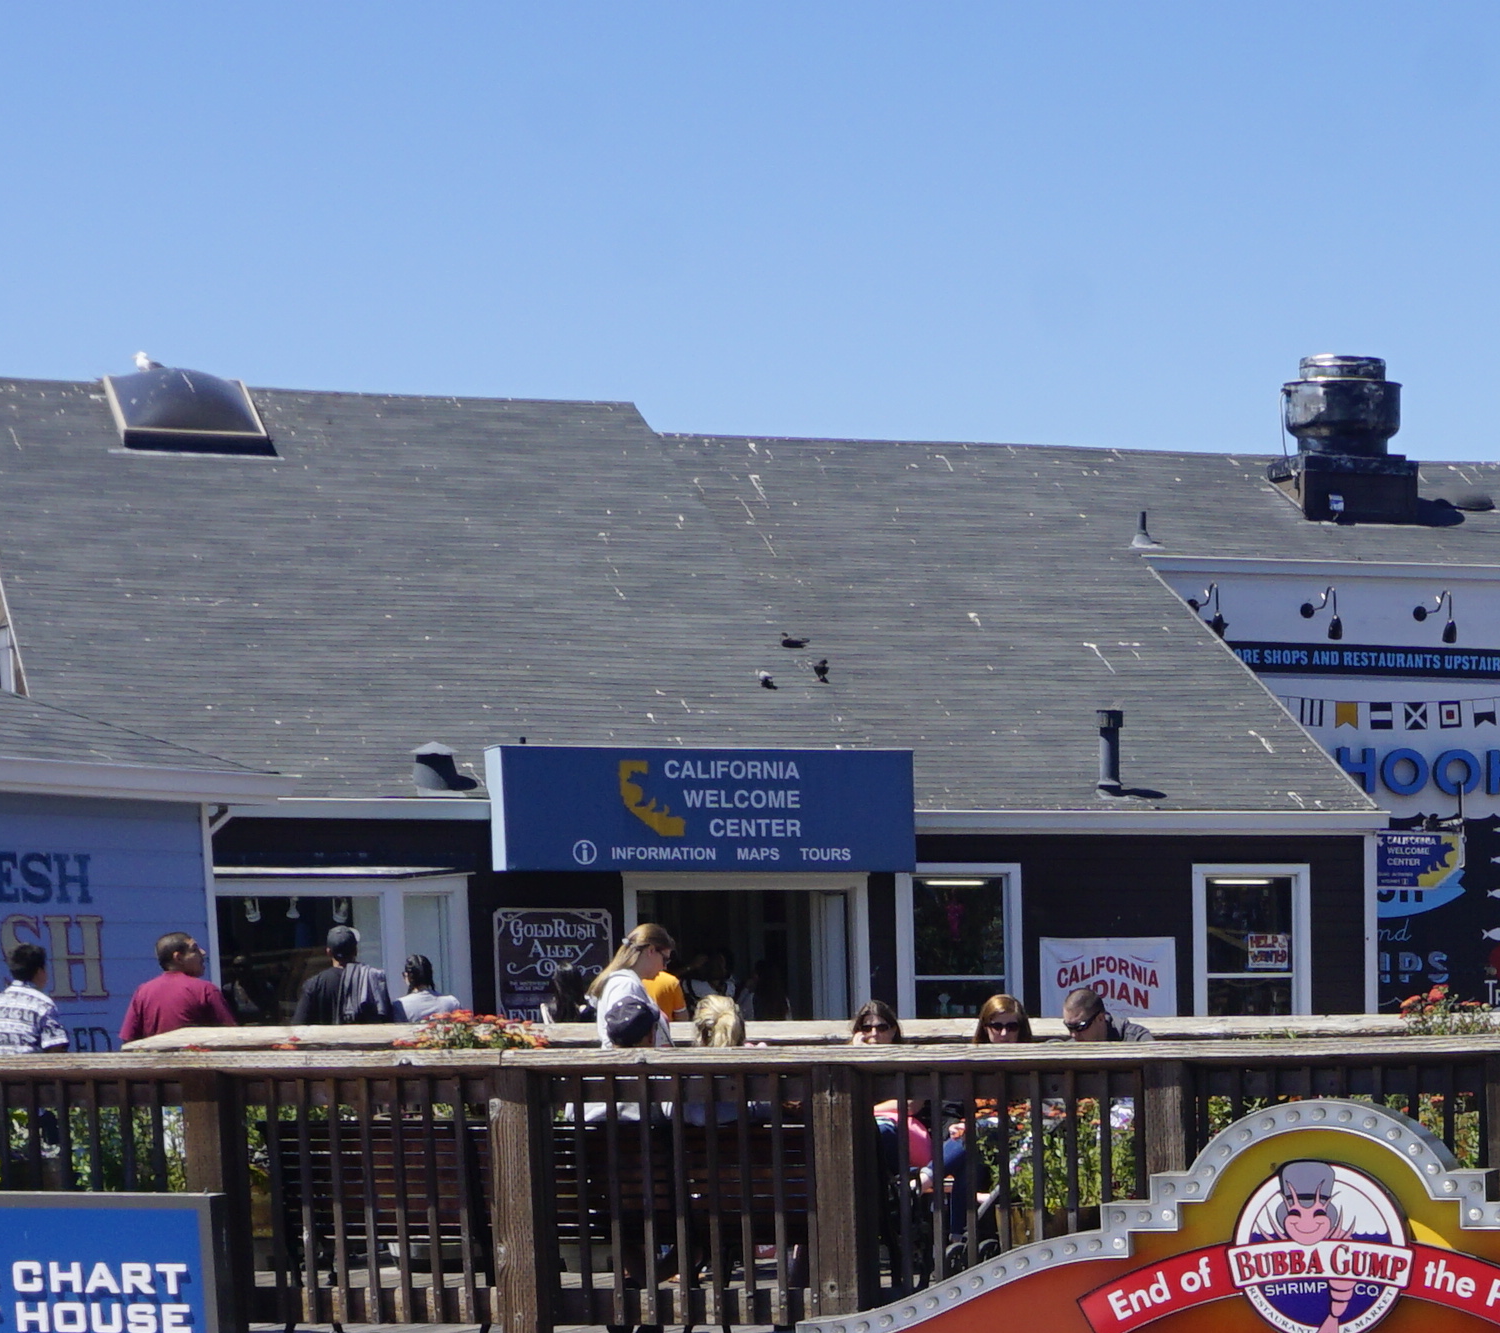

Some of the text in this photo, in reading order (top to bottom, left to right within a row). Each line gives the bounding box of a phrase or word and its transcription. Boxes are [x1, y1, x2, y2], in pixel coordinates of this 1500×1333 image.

[1235, 648, 1260, 664] ORE
[1264, 649, 1308, 665] SHOPS
[1312, 650, 1339, 666] AND
[1343, 651, 1441, 669] RESTAURANTS
[665, 760, 800, 780] CALIFORNIA
[683, 790, 801, 809] WELCOME
[710, 818, 802, 838] CENTER
[611, 846, 851, 862] INFORMATION MAPS TOURS
[1387, 846, 1430, 855] WELCOME
[1386, 858, 1420, 866] CENTER
[1378, 918, 1412, 942] nd
[1057, 955, 1159, 988] CALIFORNIA
[1070, 979, 1150, 1010] DIAN
[12, 1261, 188, 1295] CHART
[1107, 1271, 1171, 1322] End
[1180, 1257, 1213, 1293] of
[1424, 1259, 1483, 1298] the
[1265, 1282, 1328, 1297] SHRIMP
[1354, 1289, 1394, 1329] MARKET
